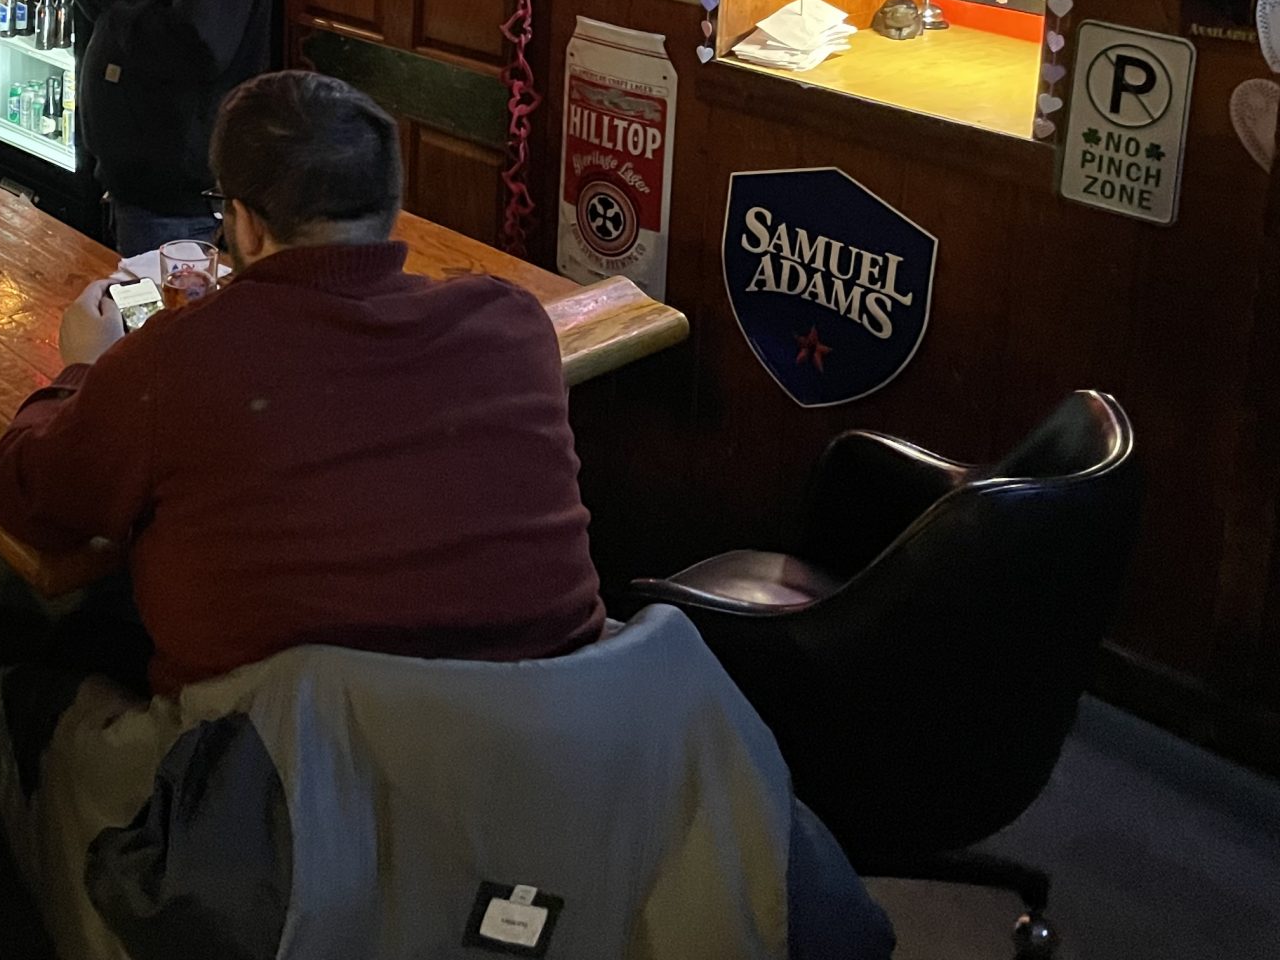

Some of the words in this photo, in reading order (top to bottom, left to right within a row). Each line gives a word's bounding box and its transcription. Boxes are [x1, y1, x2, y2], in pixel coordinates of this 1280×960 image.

[630, 82, 653, 93] LAGER
[1109, 53, 1157, 114] P
[569, 103, 662, 160] HILLTOP
[1104, 131, 1141, 158] NO
[617, 162, 651, 193] Lager
[1080, 150, 1162, 188] PINCH
[1082, 175, 1153, 210] ZONE
[740, 206, 914, 306] SAMUEL
[744, 252, 894, 340] ADAMS
